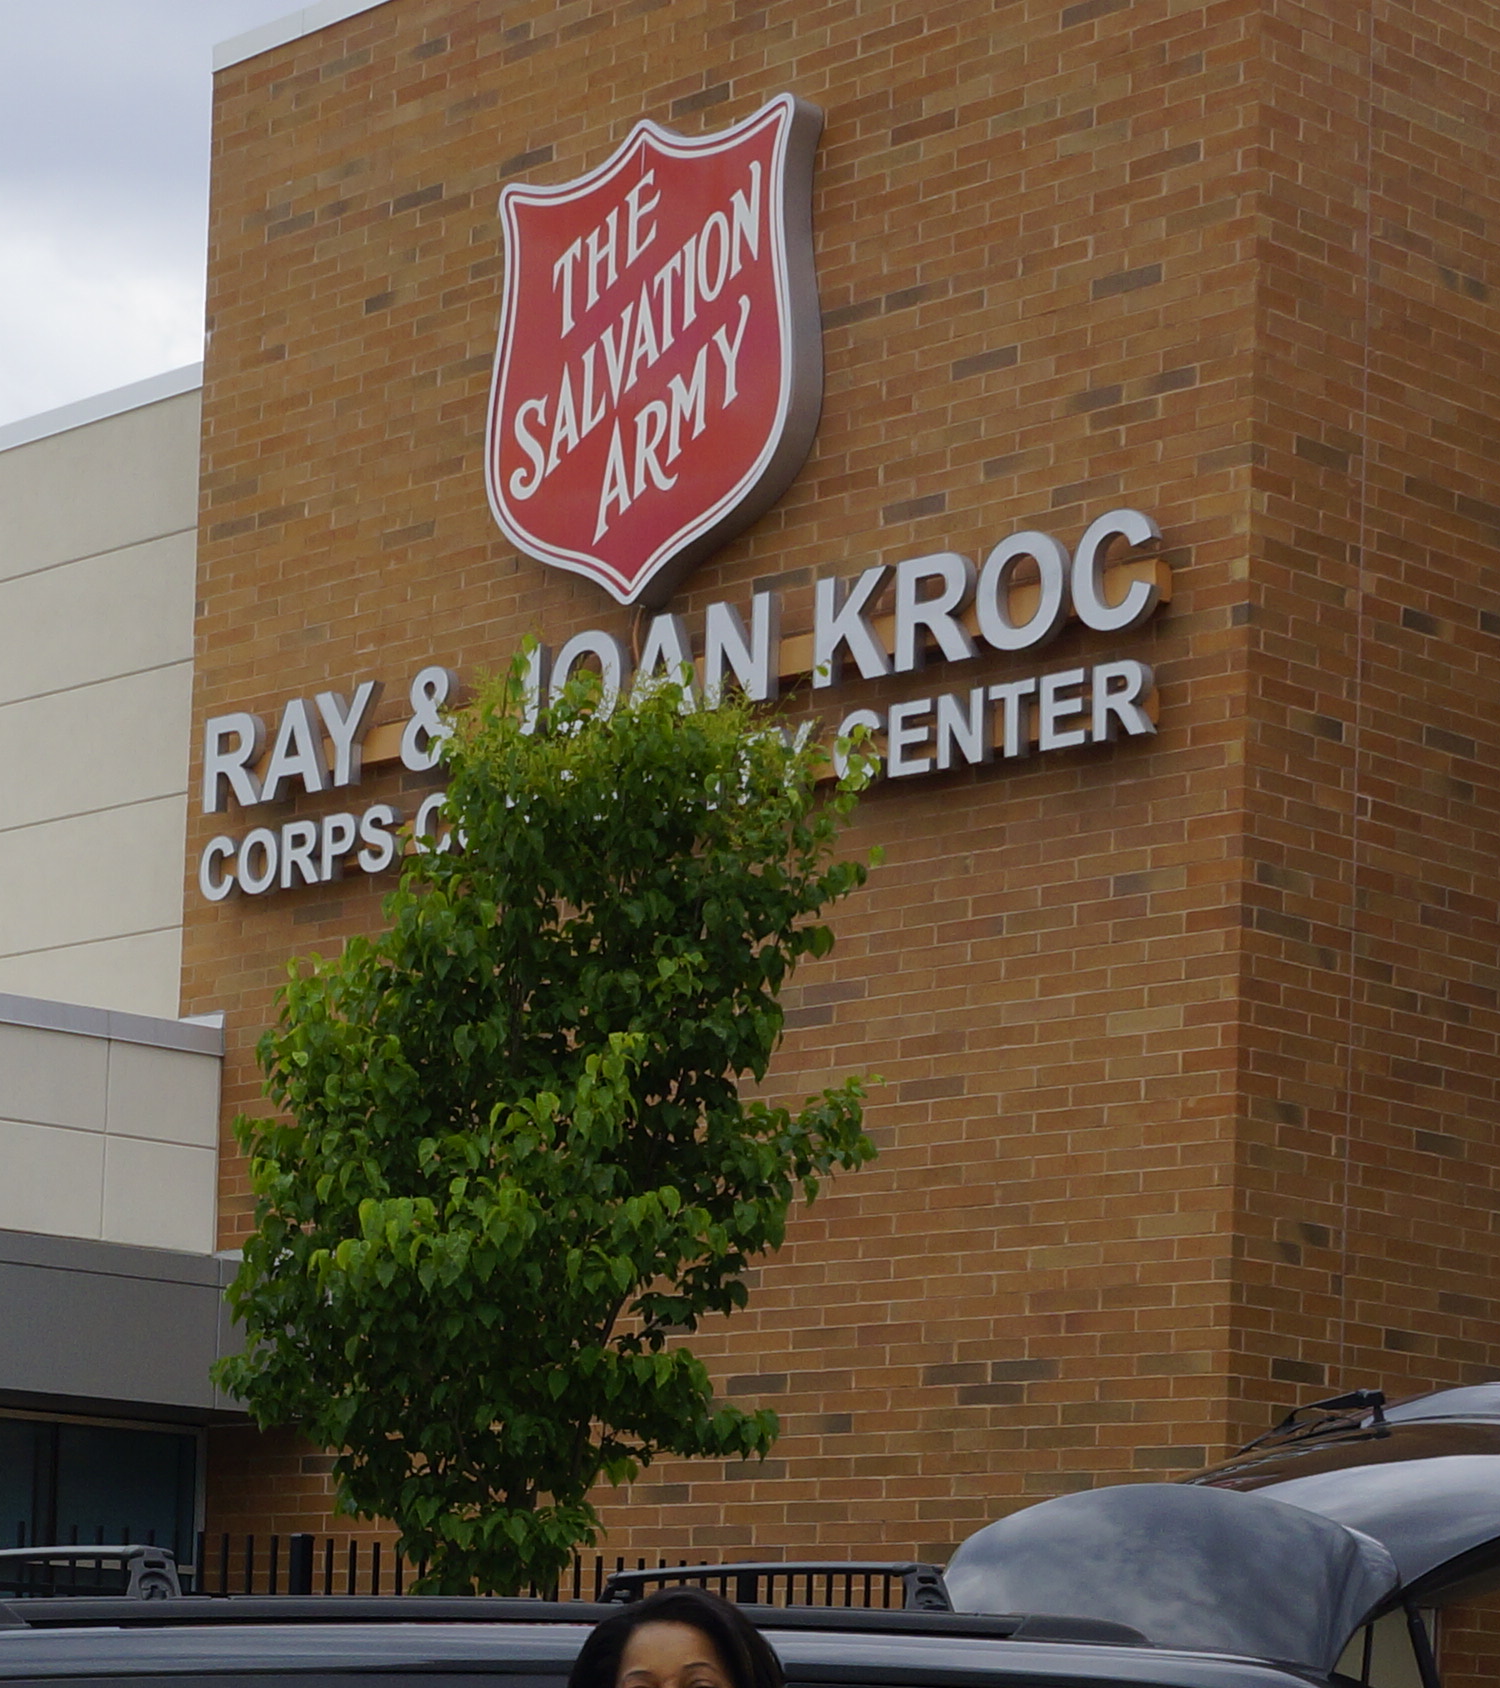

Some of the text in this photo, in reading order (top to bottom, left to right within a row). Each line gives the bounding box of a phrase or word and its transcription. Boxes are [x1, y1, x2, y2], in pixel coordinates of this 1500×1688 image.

[510, 161, 762, 500] SALVATION
[551, 167, 662, 339] THE
[592, 298, 751, 545] ARMY
[198, 659, 1157, 903] CORPS CENTER
[201, 681, 384, 814] RAY
[401, 667, 460, 772] &
[814, 509, 1162, 688] KROC
